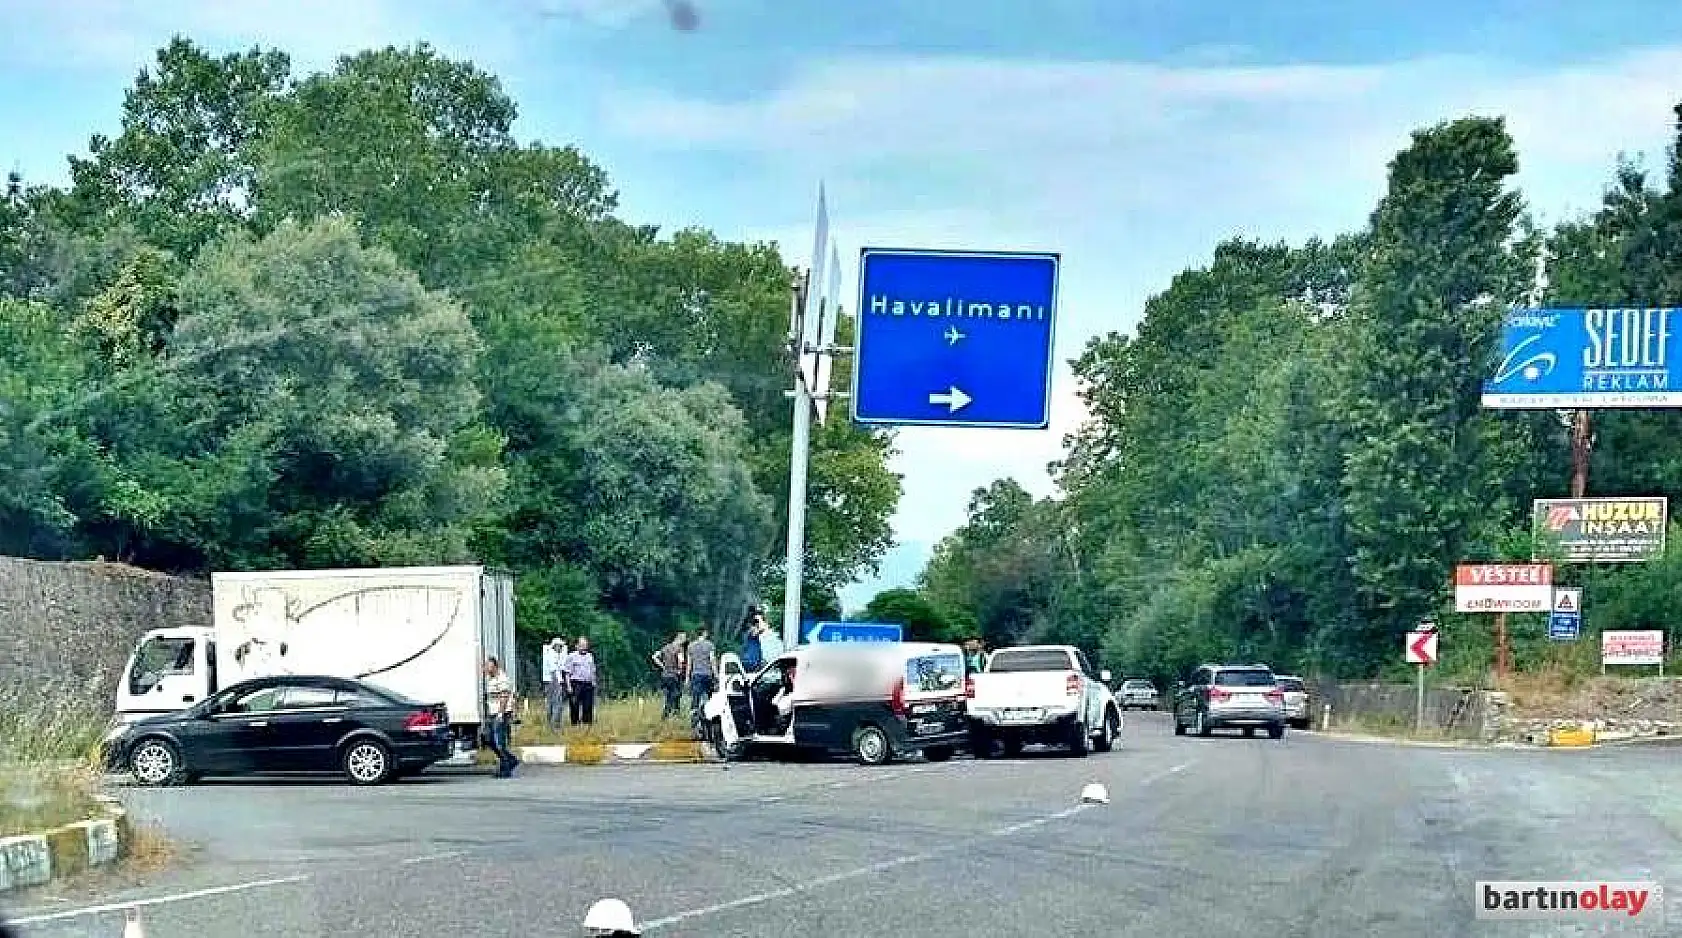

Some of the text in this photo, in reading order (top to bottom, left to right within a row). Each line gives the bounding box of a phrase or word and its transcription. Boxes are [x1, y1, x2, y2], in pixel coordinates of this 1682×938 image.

[870, 294, 1045, 320] Havalimanı
[1584, 309, 1674, 367] SEDEF
[1584, 374, 1669, 390] REKLAM
[1582, 502, 1662, 521] HUZUR
[1471, 564, 1543, 583] VESTEL
